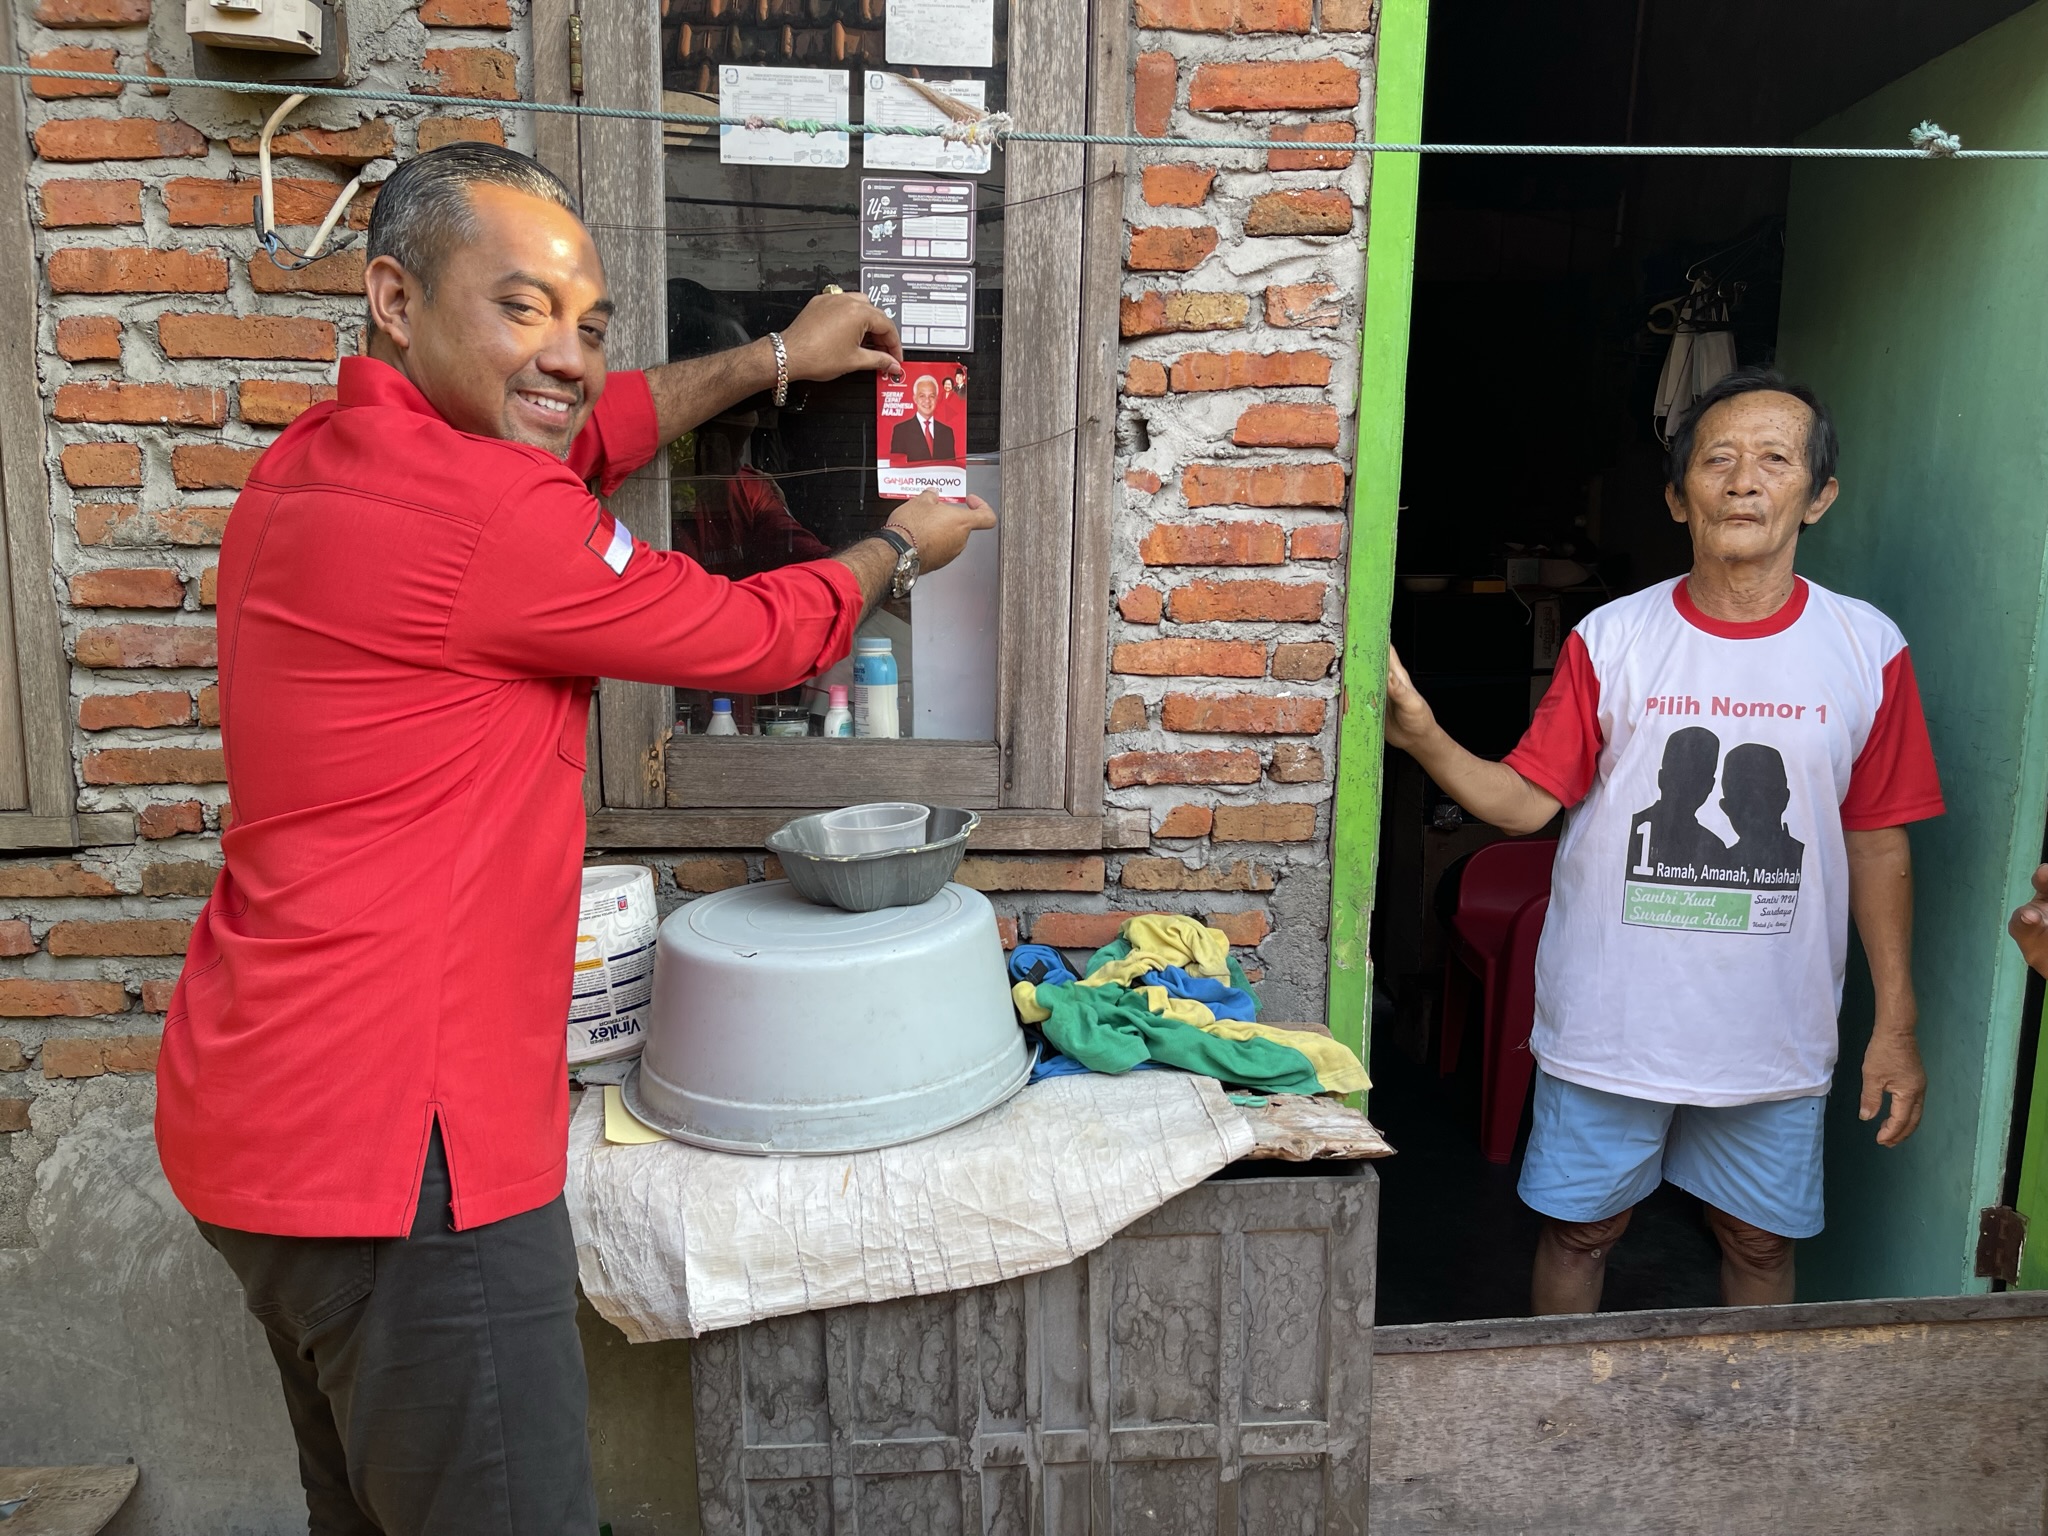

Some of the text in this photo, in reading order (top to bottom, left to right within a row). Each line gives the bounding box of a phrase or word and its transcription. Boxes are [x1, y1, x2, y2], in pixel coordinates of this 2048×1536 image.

[867, 197, 882, 221] 14
[868, 285, 882, 307] 14
[881, 408, 904, 416] MAJU
[883, 477, 961, 486] GANJAR PRANOWO
[1646, 696, 1827, 724] Pilih Nomor 1
[1632, 820, 1654, 876] 1
[1656, 862, 1801, 885] Ramah, Amanah, Maslahah
[1630, 888, 1717, 907] Santri Kuat
[1754, 894, 1780, 904] Santri
[1629, 906, 1743, 928] Surabaya Hebat
[587, 1018, 641, 1041] Vinilex
[598, 1015, 629, 1027] EXTERIOR
[589, 1036, 610, 1045] SUPER
